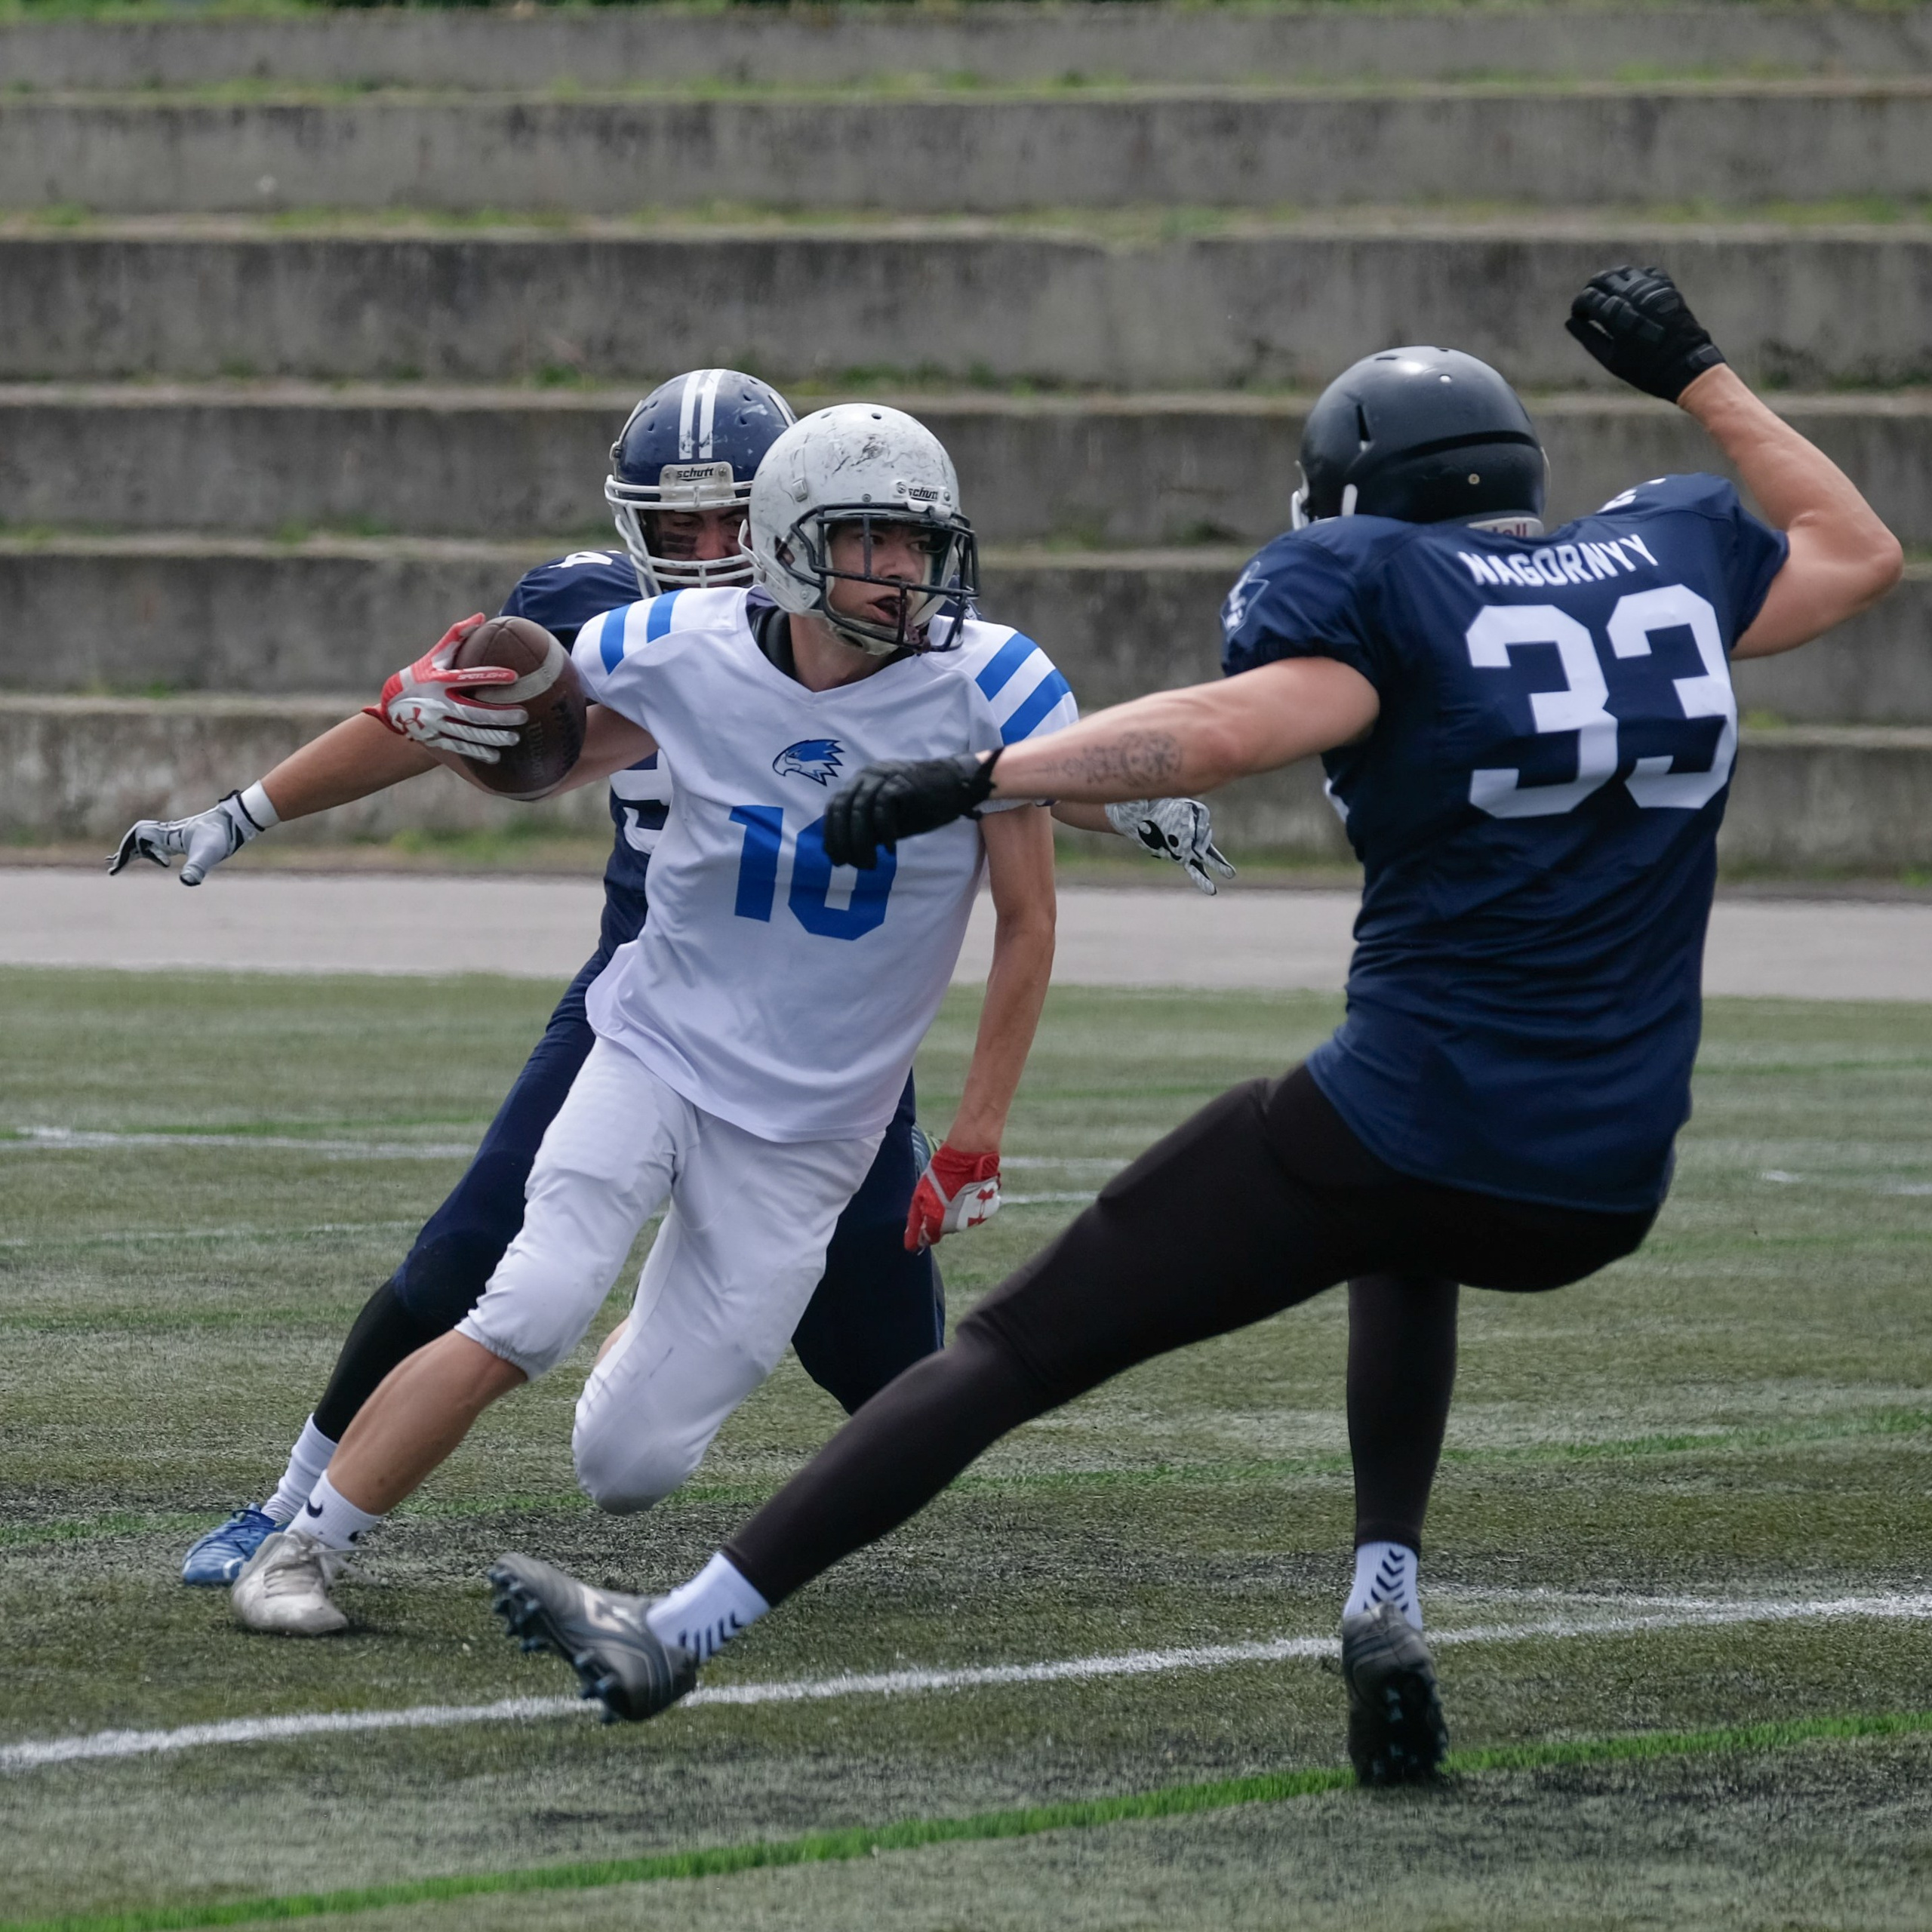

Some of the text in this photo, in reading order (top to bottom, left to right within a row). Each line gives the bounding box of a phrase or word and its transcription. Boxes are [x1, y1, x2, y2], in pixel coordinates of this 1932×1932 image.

[677, 467, 714, 478] schutt
[908, 487, 938, 500] schutt
[1457, 534, 1659, 586] NAGORNYY
[457, 672, 509, 680] SPOTLIGHT
[1465, 584, 1736, 819] 33
